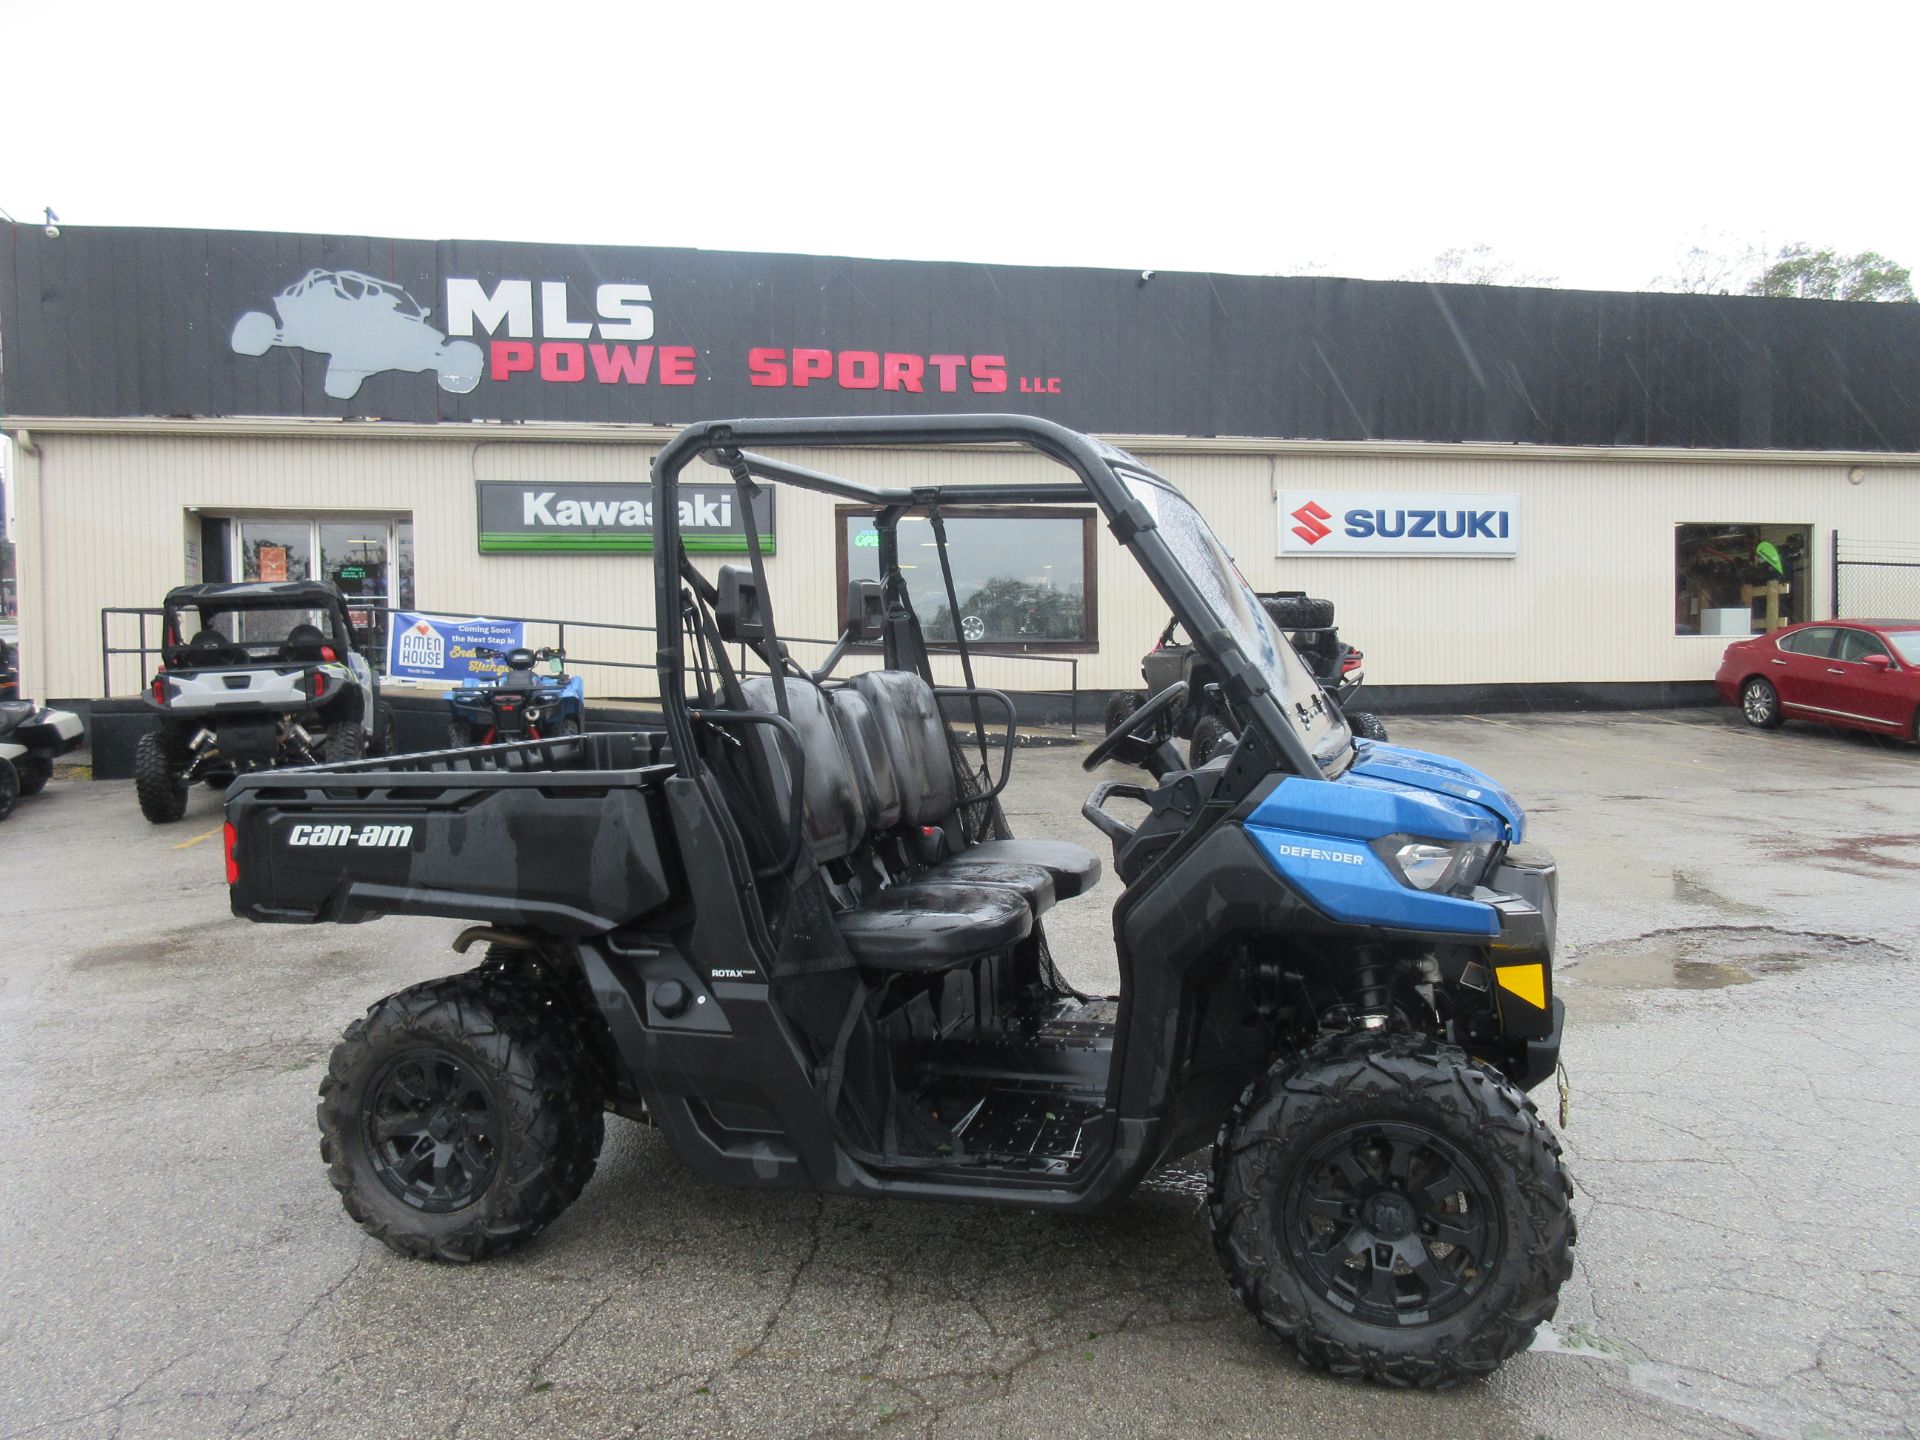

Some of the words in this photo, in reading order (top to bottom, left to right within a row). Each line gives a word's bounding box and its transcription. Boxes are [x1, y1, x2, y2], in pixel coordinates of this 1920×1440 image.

[446, 278, 654, 340] MLS
[490, 341, 697, 385] POWE
[748, 347, 1009, 393] SPORTS
[1020, 377, 1061, 393] LLC
[1344, 509, 1509, 538] SUZUKI
[854, 535, 879, 547] OPE
[458, 625, 489, 635] Coming
[490, 626, 511, 634] Soon
[403, 635, 441, 651] AMEN
[451, 634, 466, 642] the
[467, 635, 486, 643] Next
[487, 636, 506, 645] Step
[402, 650, 441, 666] HOUSE
[289, 825, 413, 847] can-am
[1280, 844, 1364, 865] DEFENDER
[711, 969, 744, 978] ROTAX
